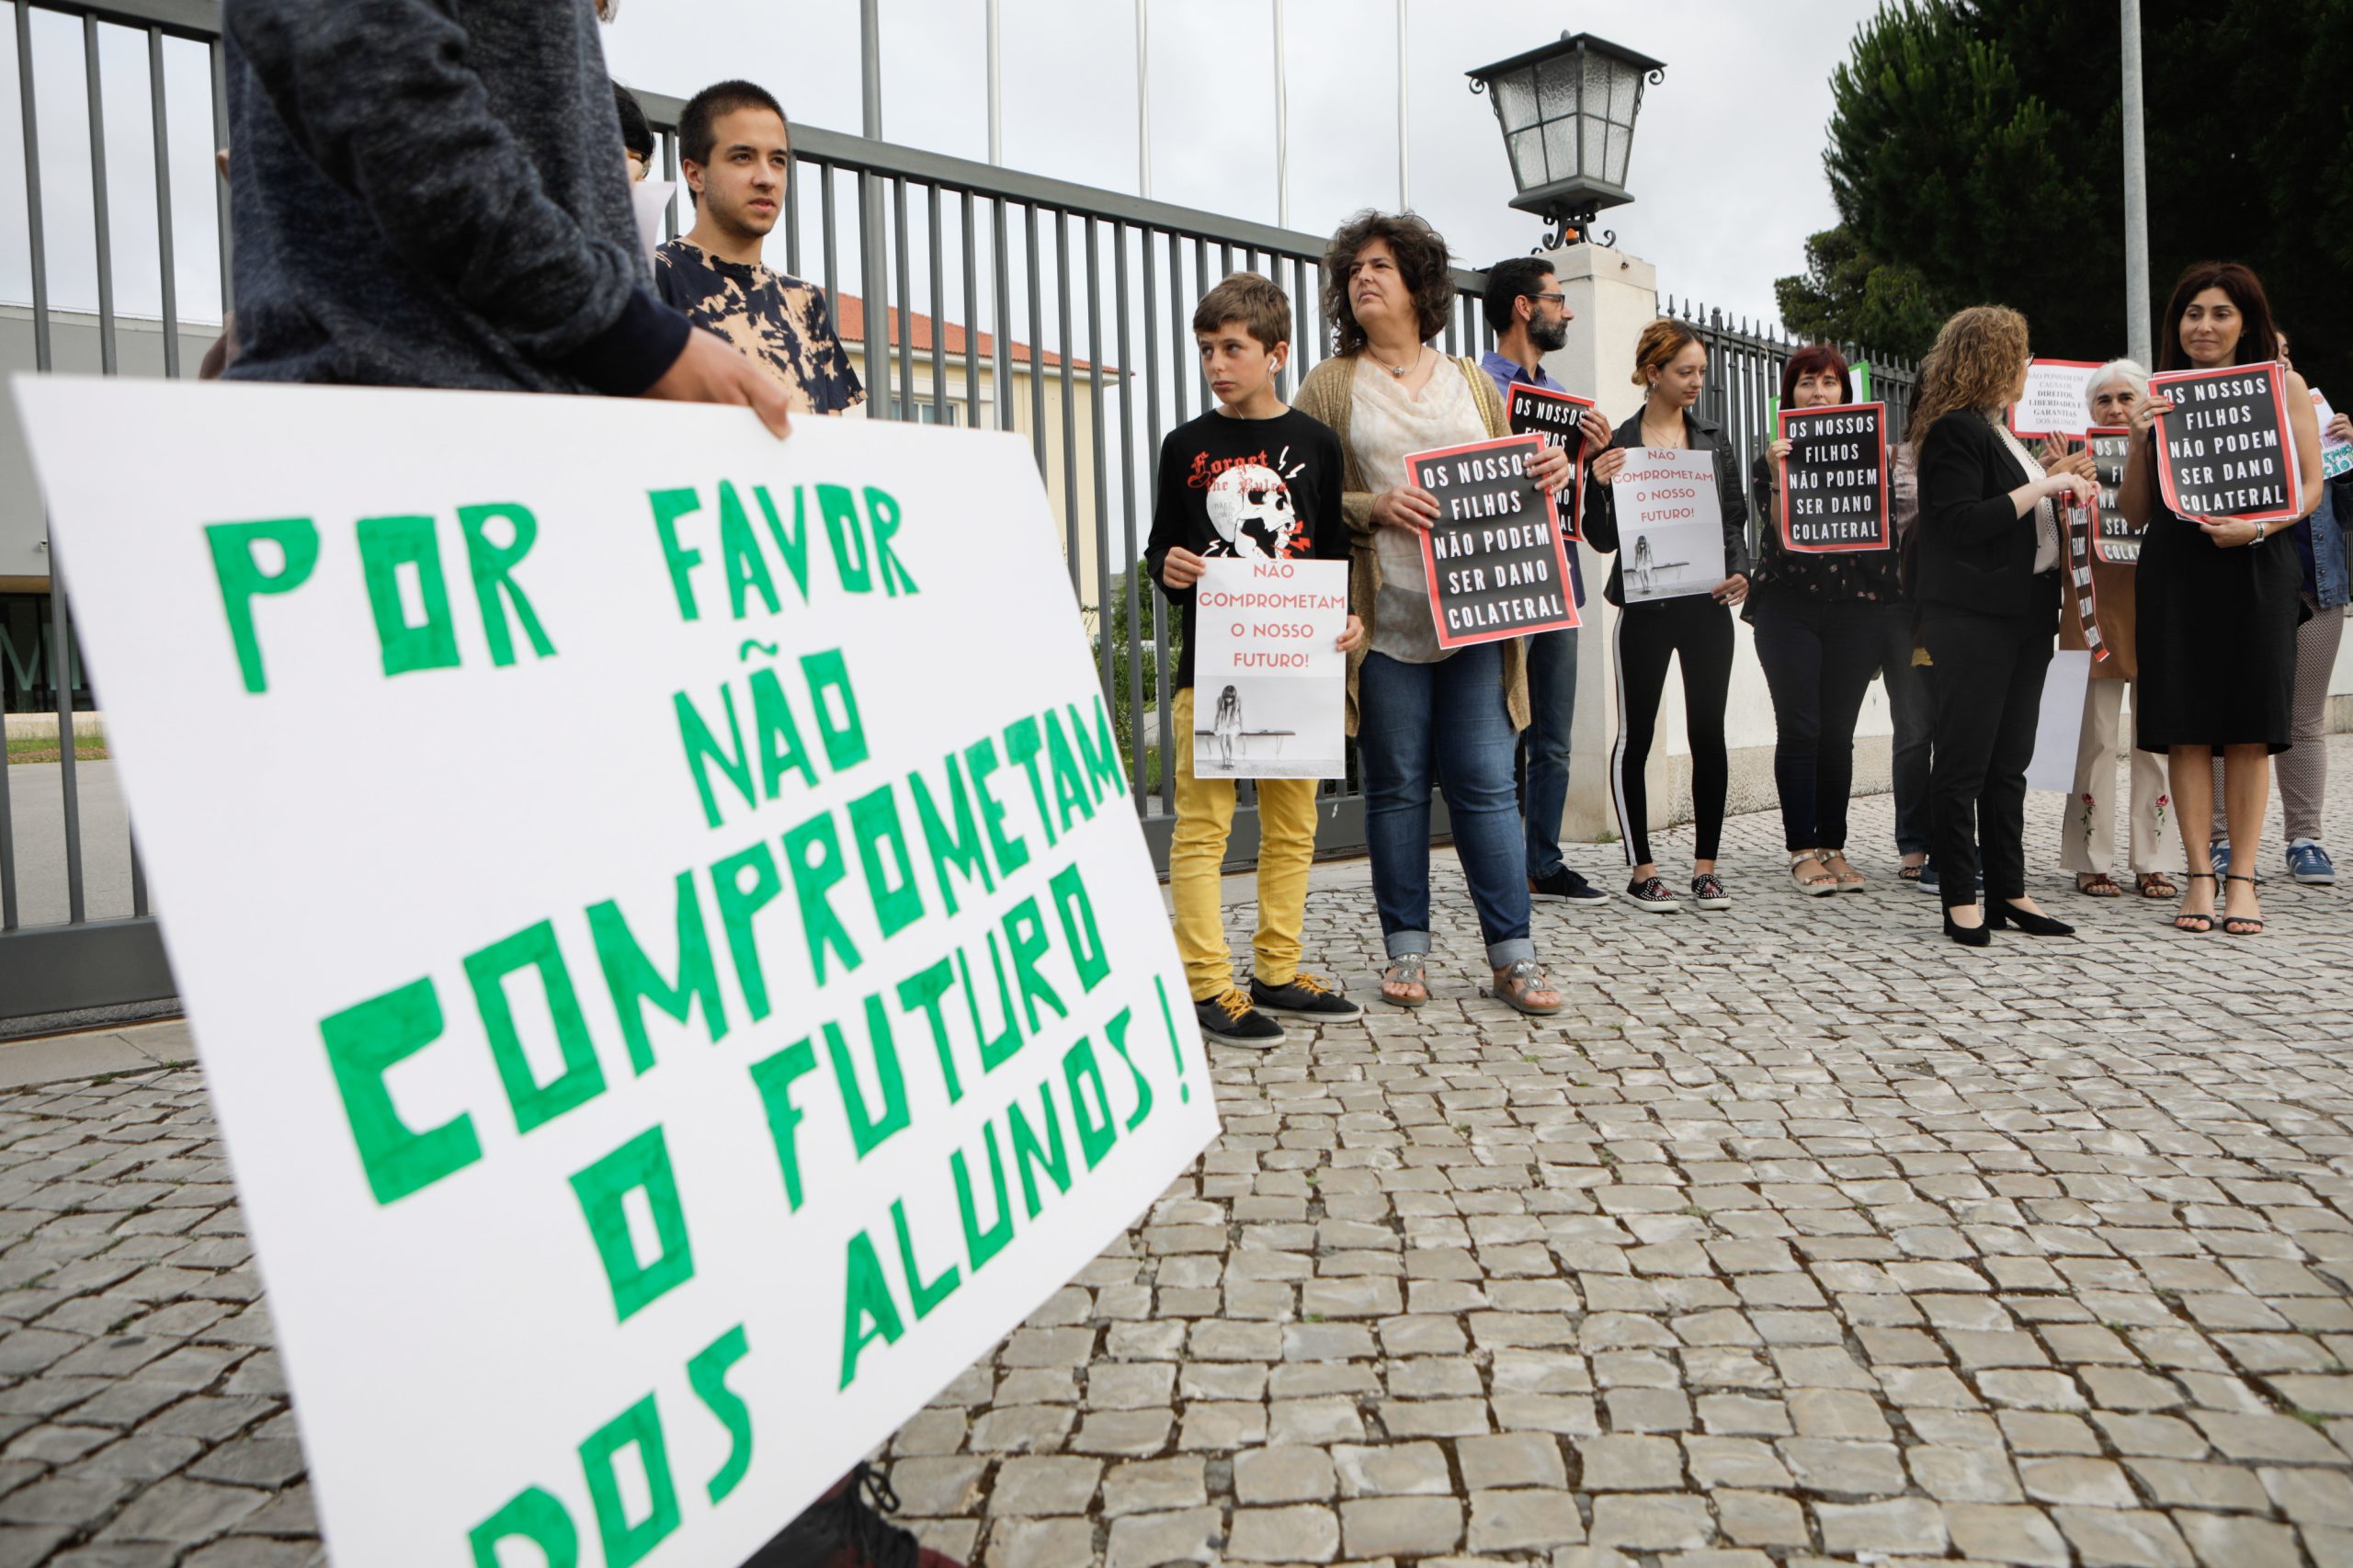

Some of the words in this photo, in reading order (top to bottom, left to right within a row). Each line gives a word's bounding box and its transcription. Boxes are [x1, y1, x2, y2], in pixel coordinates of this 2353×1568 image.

[2038, 390, 2075, 399] DIREITOS,
[2164, 387, 2186, 404] OS
[2194, 378, 2267, 402] NOSSOS
[1515, 398, 1531, 416] OS
[2029, 400, 2076, 409] LIBERDADES
[2033, 409, 2077, 417] GARANTIAS
[1790, 422, 1807, 438] OS
[1815, 415, 1874, 437] NOSSOS
[2186, 405, 2252, 430] FILHOS
[1805, 443, 1859, 463] FILHOS
[2096, 440, 2112, 456] OS
[2169, 437, 2204, 459] NÃO
[2213, 429, 2277, 454] PODEM
[1648, 449, 1676, 460] NÃO
[1188, 449, 1268, 488] Forget
[1423, 465, 1449, 489] OS
[1613, 470, 1713, 483] COMPROMETAM
[2181, 467, 2213, 485] SER
[2222, 458, 2274, 481] DANO
[1237, 478, 1287, 496] Rules
[1790, 471, 1818, 489] NÃO
[1826, 469, 1877, 488] PODEM
[1450, 490, 1521, 520] FILHOS
[1636, 492, 1646, 502] O
[1652, 489, 1695, 500] NOSSO
[1797, 498, 1824, 515] SER
[1832, 495, 1871, 514] DANO
[2180, 485, 2284, 512] COLATERAL
[1641, 507, 1694, 522] FUTURO!
[1792, 521, 1879, 540] COLATERAL
[2106, 517, 2128, 535] SER
[1434, 531, 1474, 560] NÃO
[1483, 523, 1550, 552] PODEM
[1254, 561, 1294, 578] NÃO
[1449, 569, 1485, 595] SER
[1495, 559, 1548, 588] DANO
[205, 503, 557, 694] POR
[648, 479, 919, 621] FAVOR
[1199, 592, 1345, 608] COMPROMETAM
[1448, 595, 1563, 630] COLATERAL
[1231, 623, 1245, 637] O
[1254, 624, 1313, 638] NOSSO
[1233, 653, 1309, 667] FUTURO!
[673, 639, 869, 829] NÃO
[319, 695, 1125, 1206] COMPROMETAM
[568, 1123, 695, 1324] O
[749, 862, 1110, 1212] FUTURO
